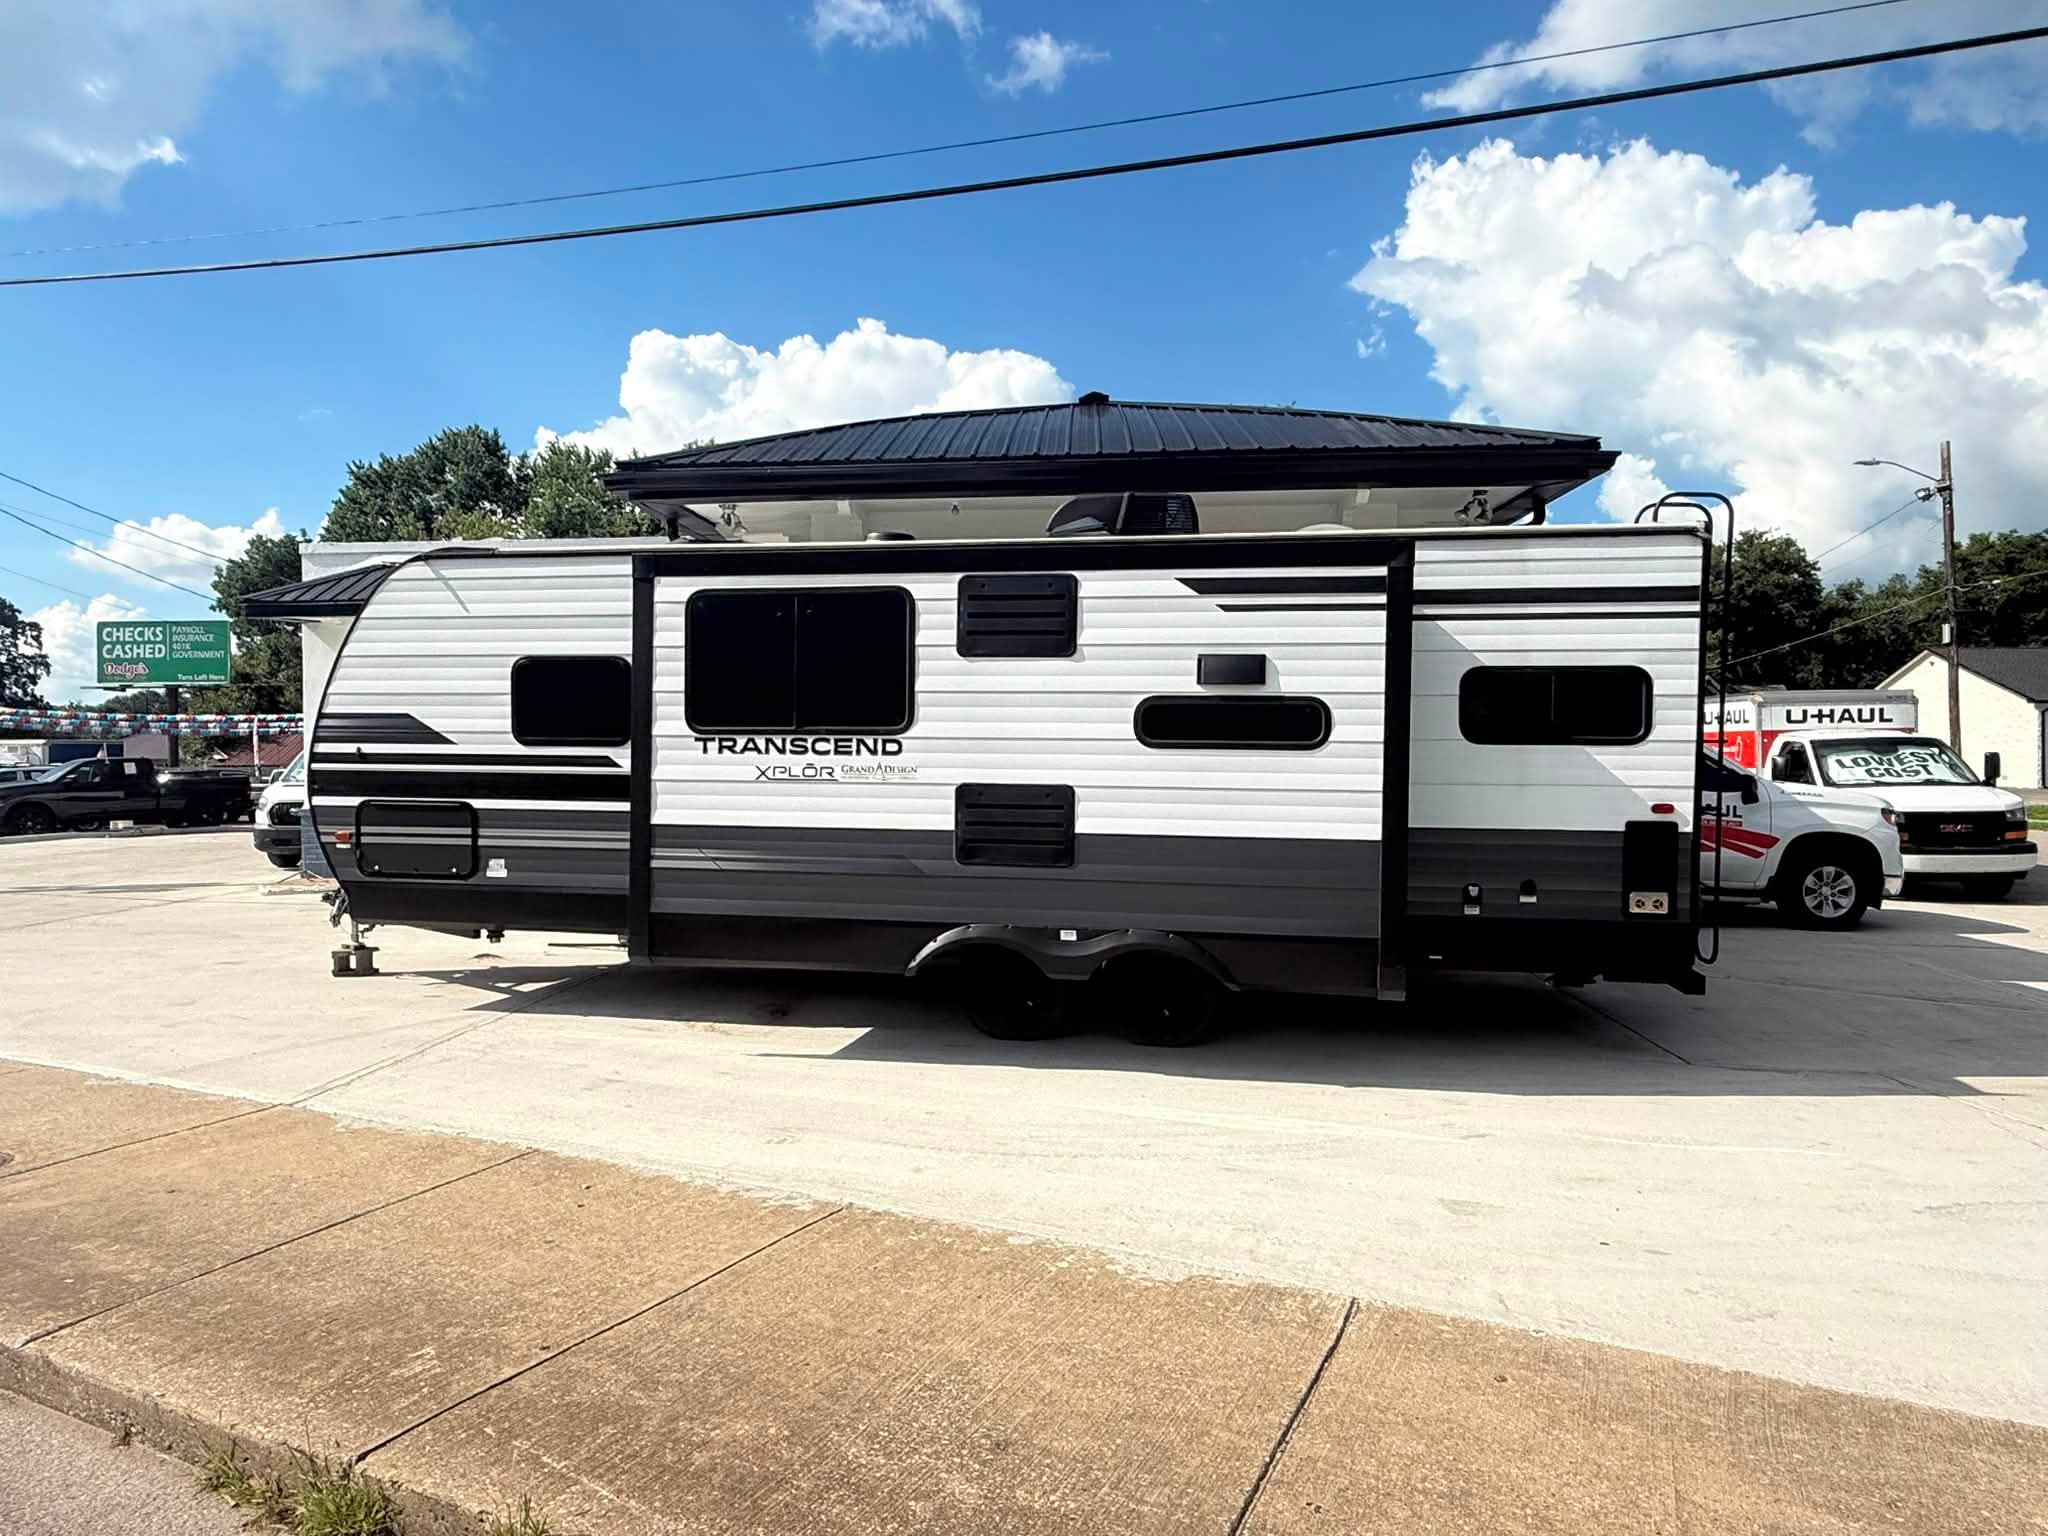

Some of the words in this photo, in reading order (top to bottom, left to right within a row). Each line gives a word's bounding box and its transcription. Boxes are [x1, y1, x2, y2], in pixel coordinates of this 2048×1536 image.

[102, 626, 163, 642] CHECKS
[172, 626, 205, 634] PAYROLL
[172, 634, 214, 642] INSURANCE
[102, 644, 166, 659] CASHED
[172, 650, 225, 659] GOVERNMENT
[177, 673, 193, 681] Turn
[194, 673, 208, 681] Left
[208, 673, 225, 681] Here
[1785, 707, 1894, 725] U-HAUL
[694, 736, 904, 757] TRANSCEND
[1835, 751, 1941, 769] LOWEST
[1864, 763, 1934, 778] COST
